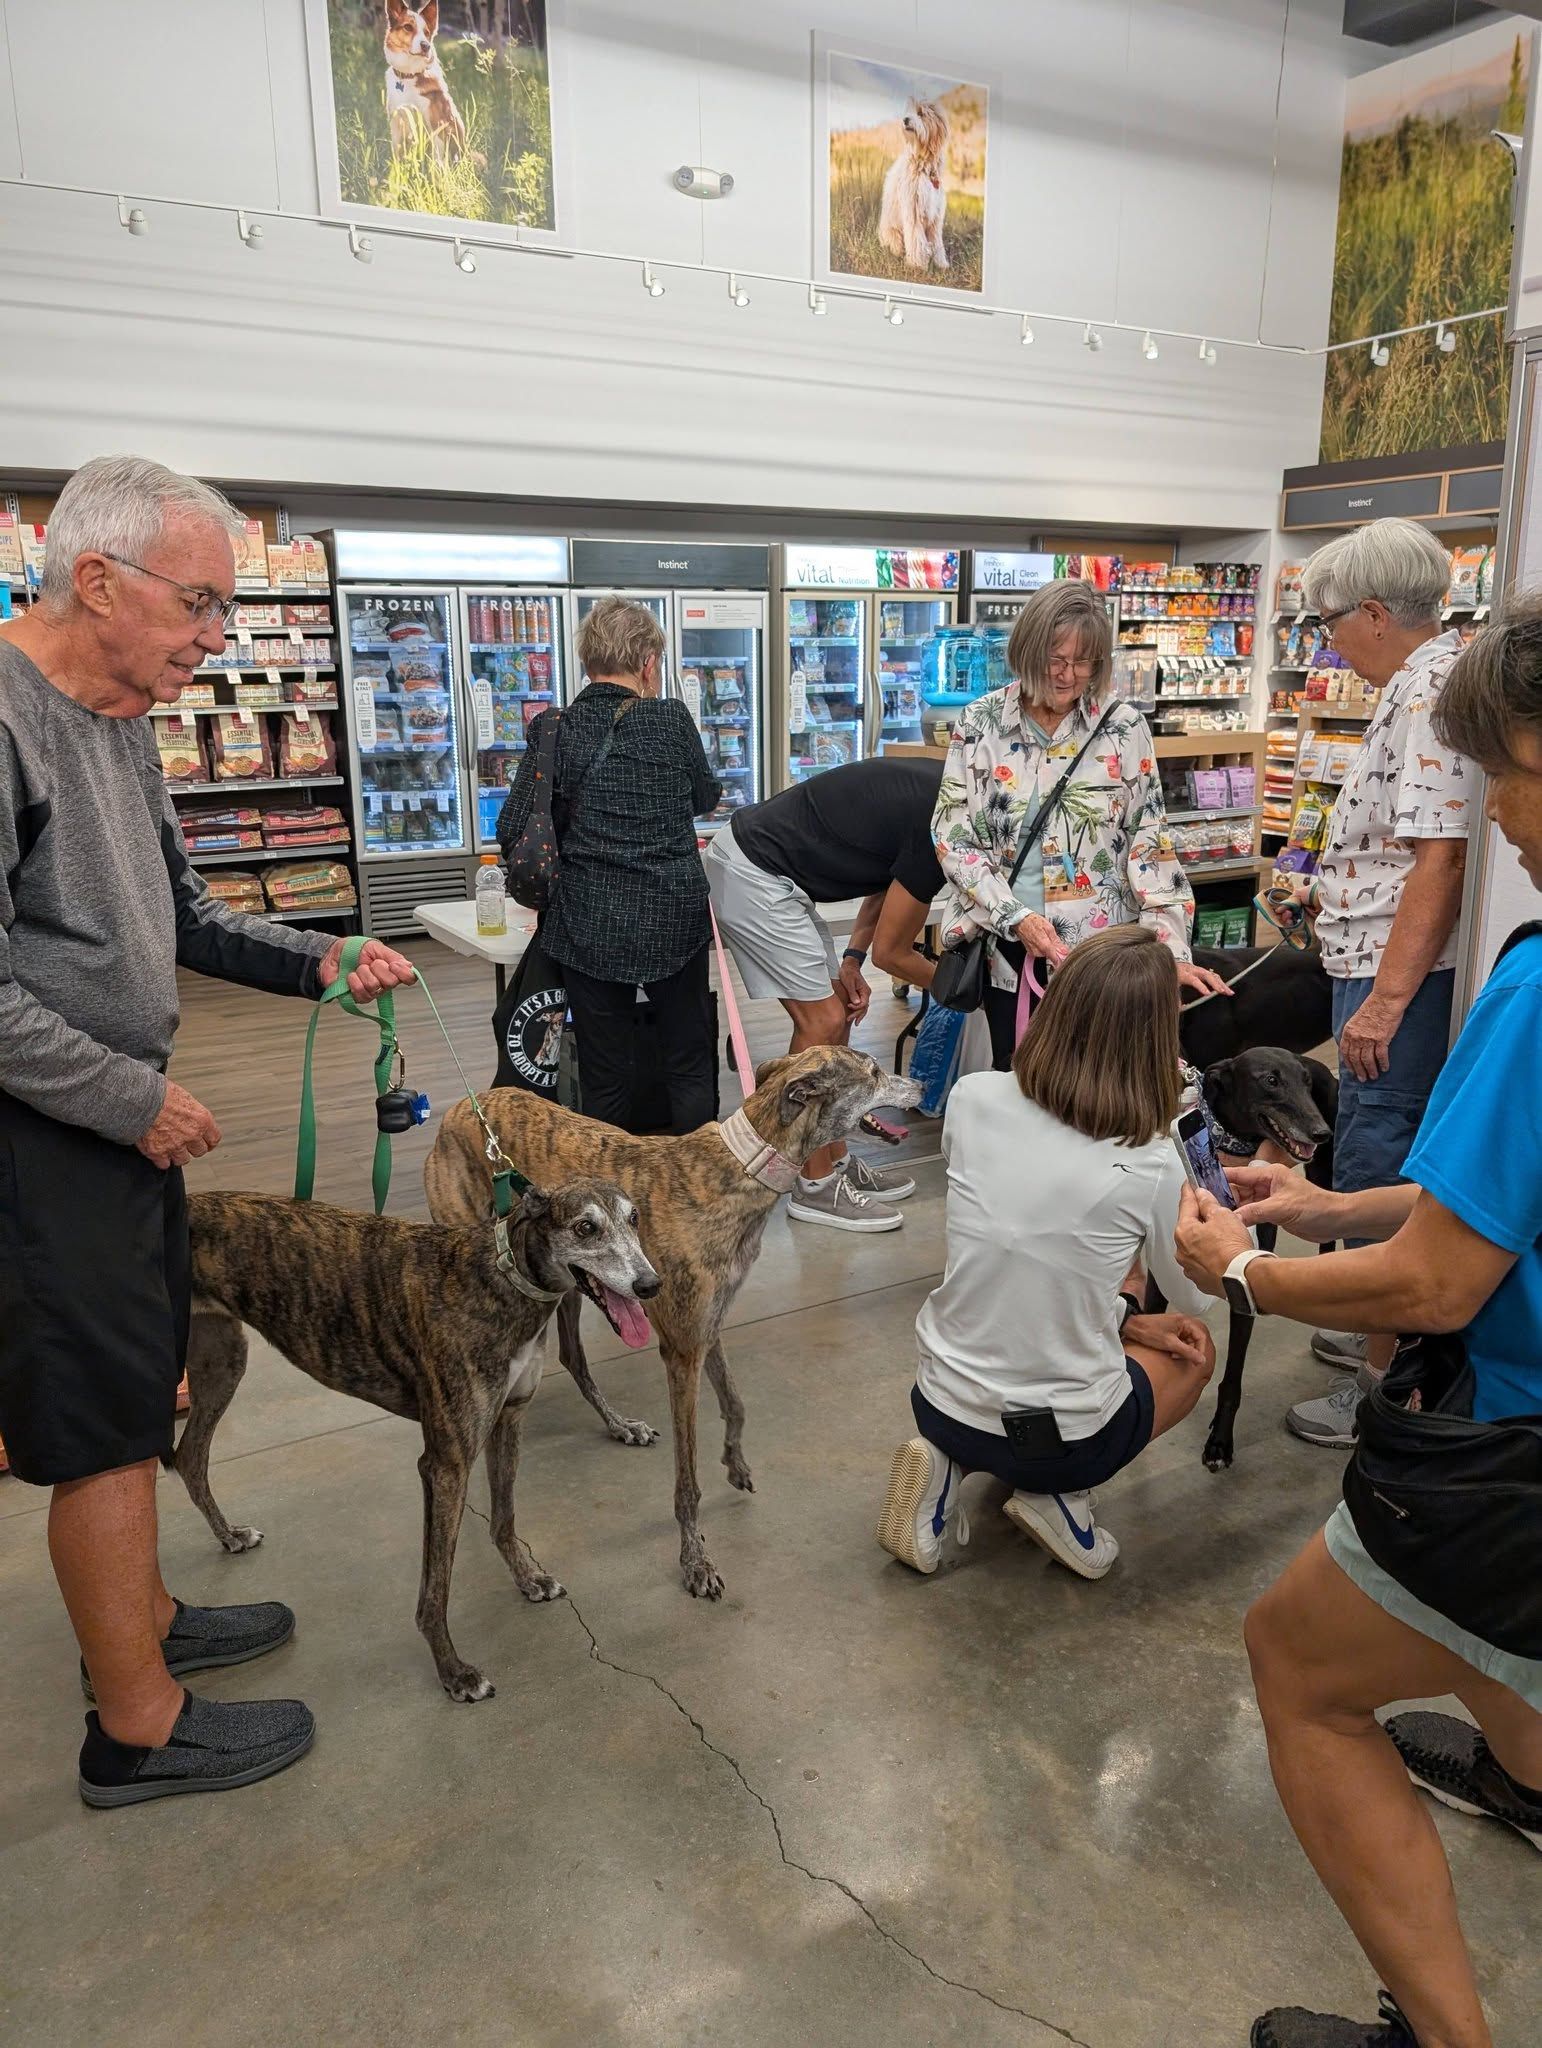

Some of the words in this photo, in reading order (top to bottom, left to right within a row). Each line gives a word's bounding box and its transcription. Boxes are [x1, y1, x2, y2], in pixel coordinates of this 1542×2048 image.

[1348, 498, 1373, 508] Instinct
[658, 559, 689, 570] Instinct
[797, 564, 835, 584] vital
[838, 576, 870, 585] Nutrition
[983, 568, 1016, 587] vital
[1019, 570, 1039, 578] Clean
[1019, 580, 1047, 588] Nutritio
[364, 599, 435, 612] FROZEN
[480, 600, 545, 611] FROZEN
[161, 733, 191, 741] ESSENTIAL
[227, 730, 255, 739] ESSENTIAL
[520, 996, 542, 1017] IT'S
[543, 992, 552, 1005] A
[508, 1034, 521, 1047] TO
[510, 1051, 542, 1082] ADOPT
[541, 1073, 550, 1086] A
